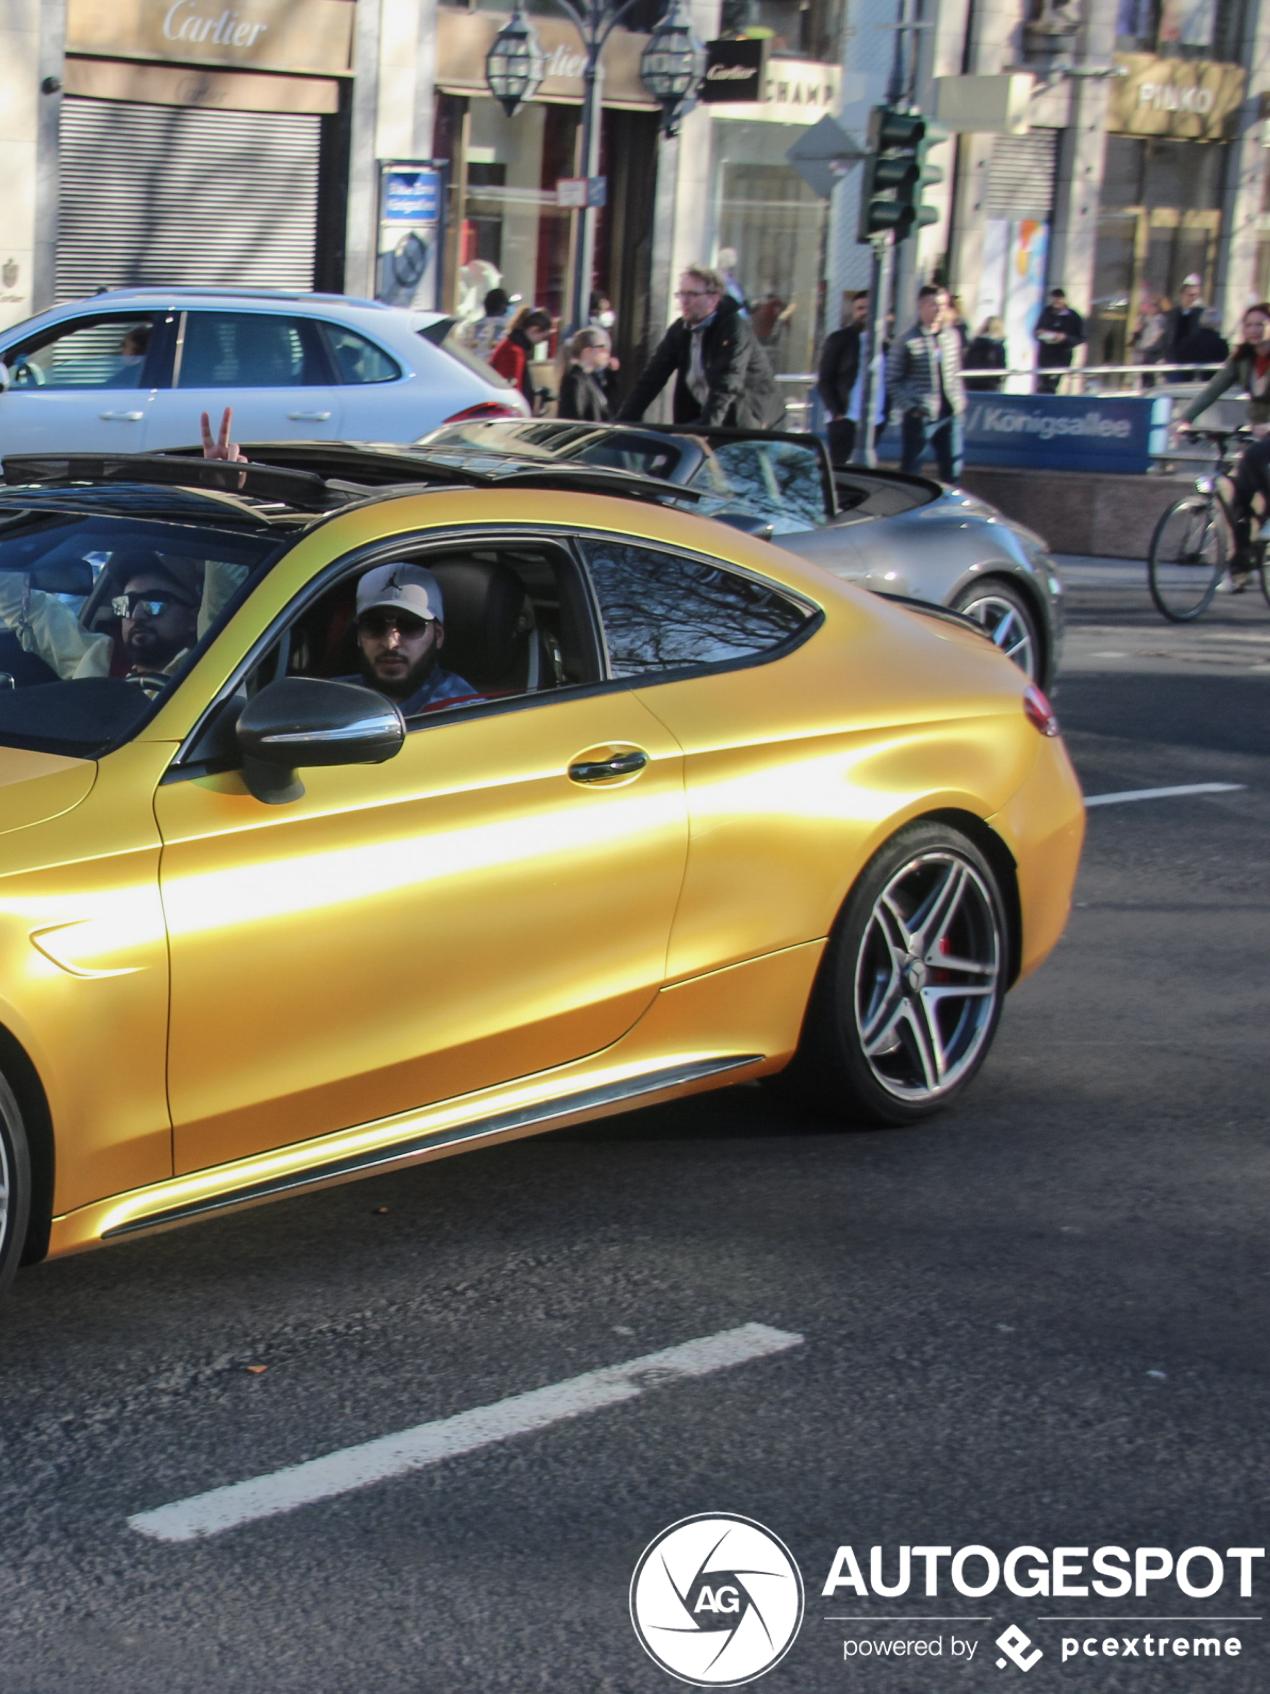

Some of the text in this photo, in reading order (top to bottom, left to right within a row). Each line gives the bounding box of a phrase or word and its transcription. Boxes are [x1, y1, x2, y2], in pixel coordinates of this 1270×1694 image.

[162, 0, 268, 47] Cartier
[706, 62, 757, 81] Cartier
[1138, 82, 1215, 113] PINKO
[983, 406, 1131, 440] Königsallee
